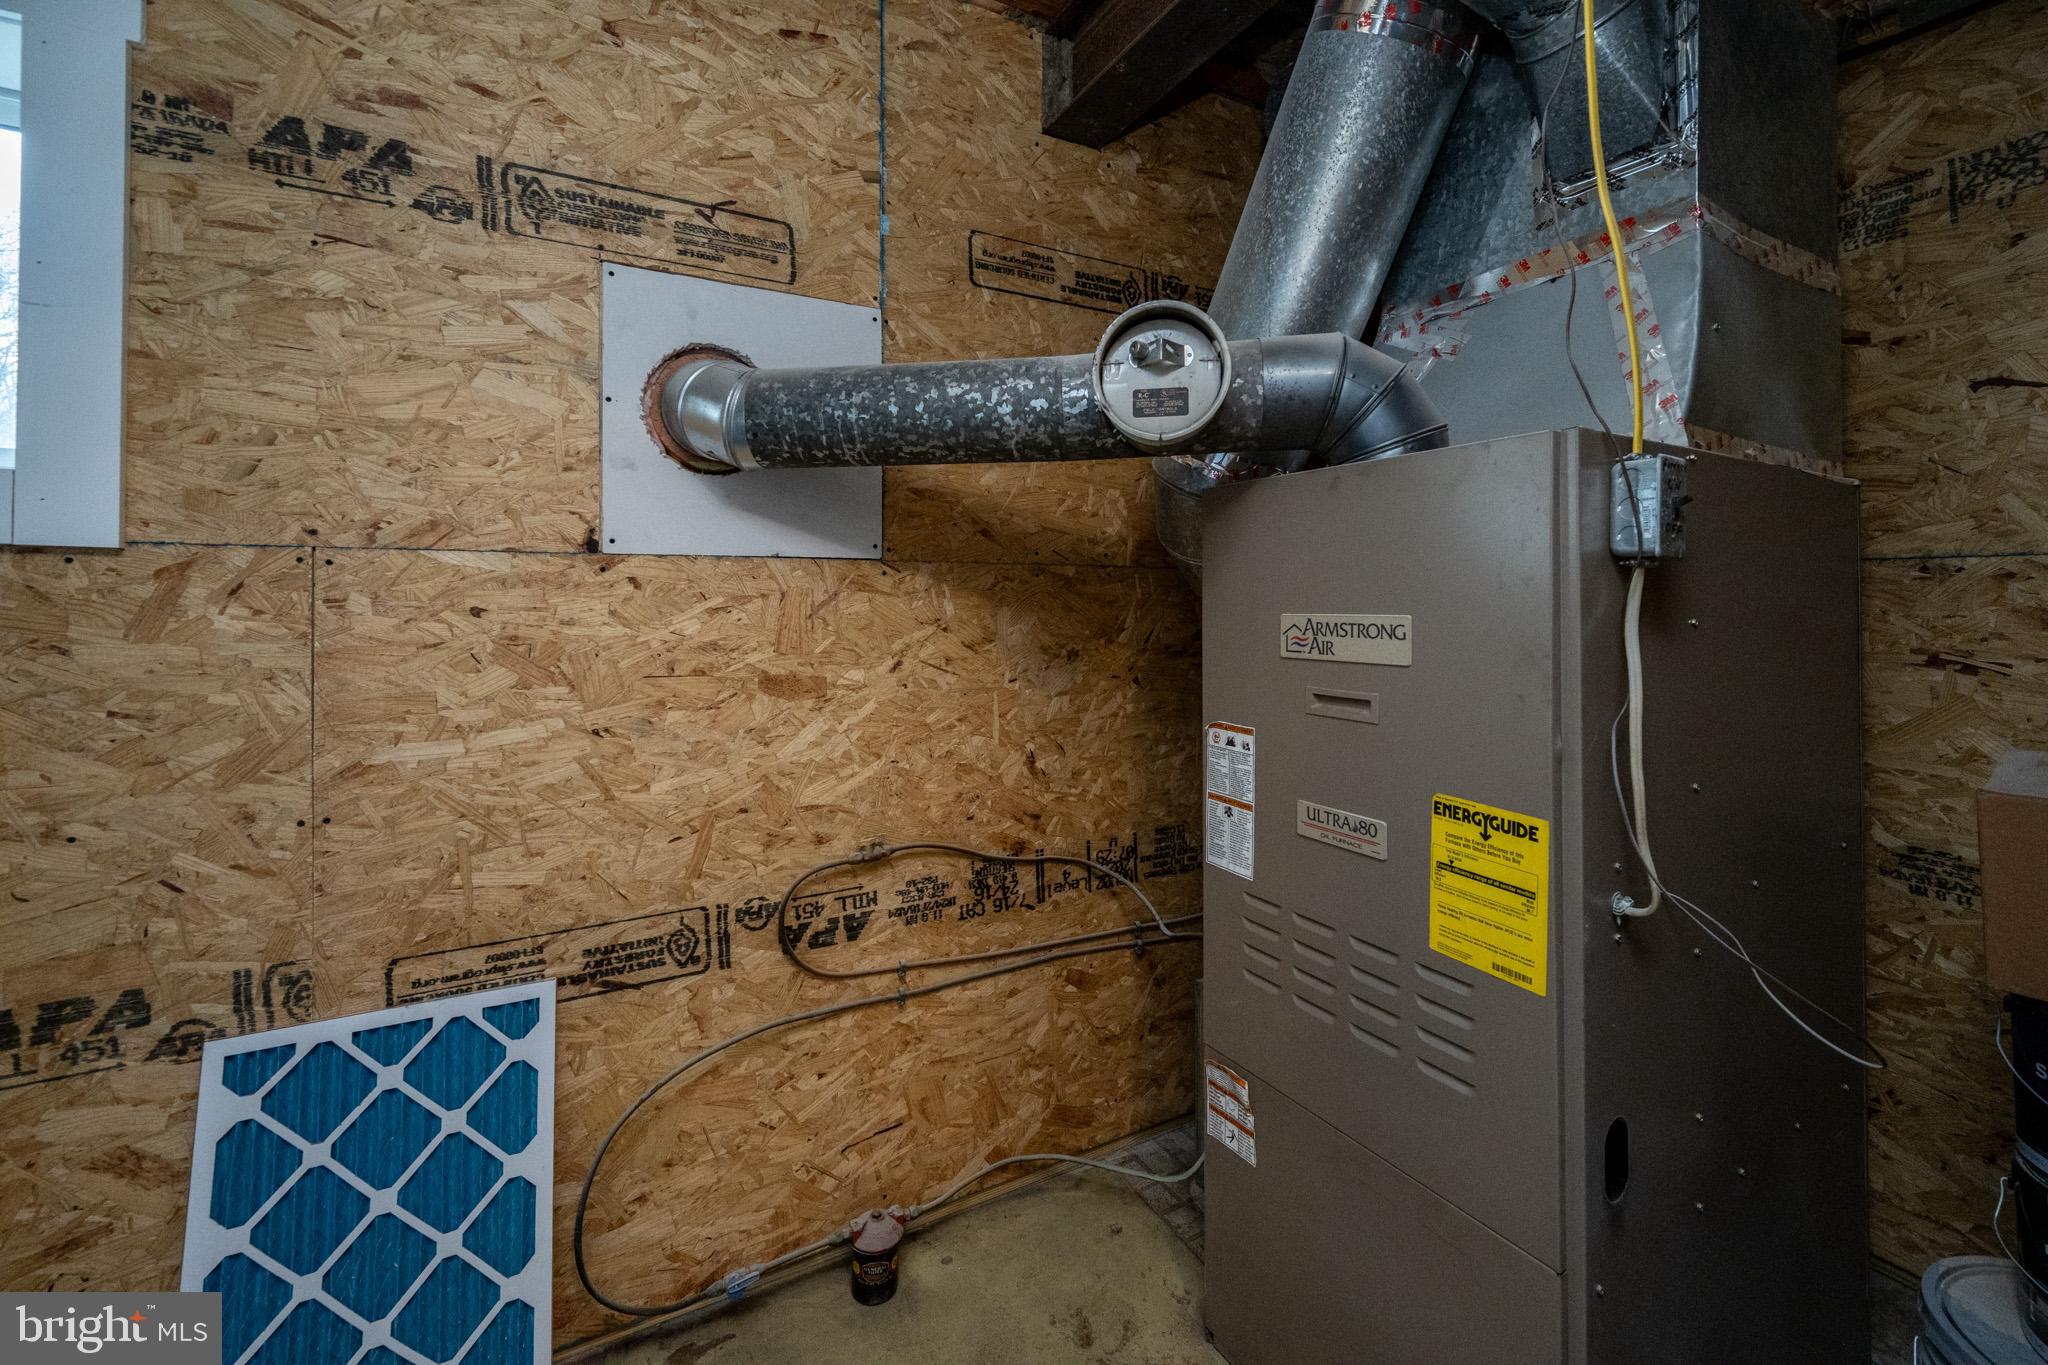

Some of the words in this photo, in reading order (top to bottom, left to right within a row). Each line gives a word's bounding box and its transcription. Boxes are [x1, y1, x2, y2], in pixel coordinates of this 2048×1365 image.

[256, 115, 417, 176] APA
[1302, 617, 1407, 641] ARMSTRONG
[1307, 636, 1336, 656] AIR
[1306, 806, 1352, 832] ULTRA
[1358, 820, 1378, 839] 80
[1433, 800, 1540, 843] ENERGYGUIDE
[834, 890, 878, 912] MILL
[974, 879, 1019, 901] 24/16
[791, 902, 825, 922] 451
[959, 901, 986, 921] CAT
[993, 891, 1028, 913] 7/16
[784, 910, 877, 951] APA
[581, 946, 666, 972] FORESTRY
